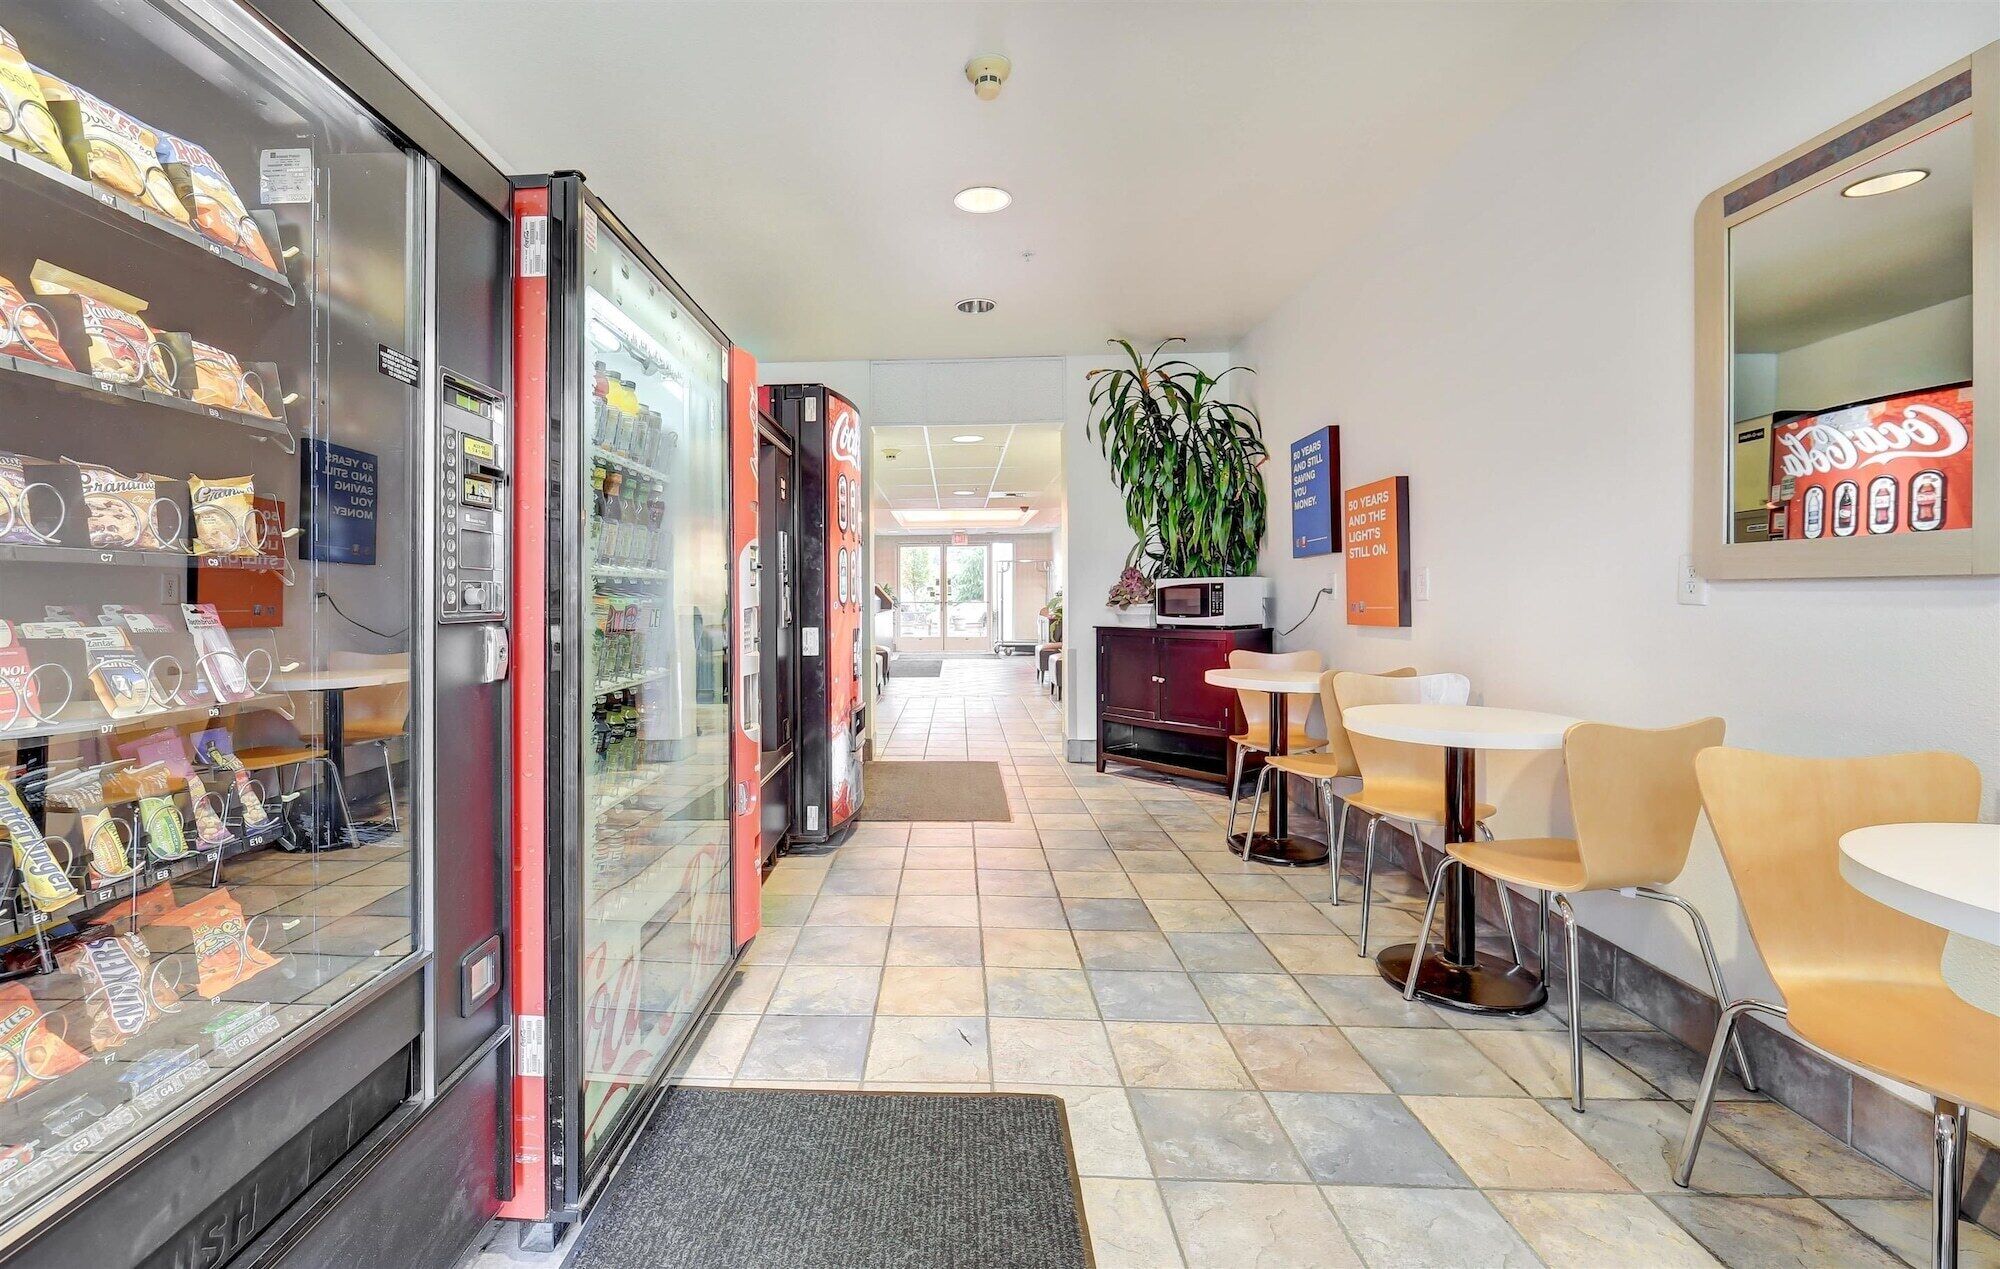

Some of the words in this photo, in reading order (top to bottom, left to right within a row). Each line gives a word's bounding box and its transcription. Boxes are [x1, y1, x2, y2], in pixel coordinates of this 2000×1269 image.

[101, 193, 114, 204] A7
[100, 382, 113, 392] B7
[1293, 450, 1301, 461] 50
[1301, 440, 1322, 457] YEARS
[1293, 460, 1307, 474] AND
[1307, 453, 1323, 468] STILL
[1293, 469, 1316, 486] SAVING
[1294, 485, 1307, 498] YOU
[1294, 496, 1318, 511] MONEY.
[1348, 499, 1358, 511] 50
[1360, 490, 1389, 508] YEARS
[1349, 513, 1367, 528] AND
[1369, 509, 1386, 523] THE
[1349, 527, 1381, 543] LIGHT'S
[1349, 545, 1370, 559] STILL
[1372, 543, 1389, 556] ON.
[100, 554, 113, 562] C7
[207, 558, 219, 567] C9
[101, 724, 114, 734] D7
[249, 836, 263, 846] E10
[207, 852, 218, 862] E9
[156, 870, 169, 880] E8
[100, 889, 113, 900] E7
[33, 912, 48, 924] E6
[85, 937, 144, 1031] SNICKERS
[160, 1085, 174, 1097] G4
[73, 1137, 89, 1152] G3
